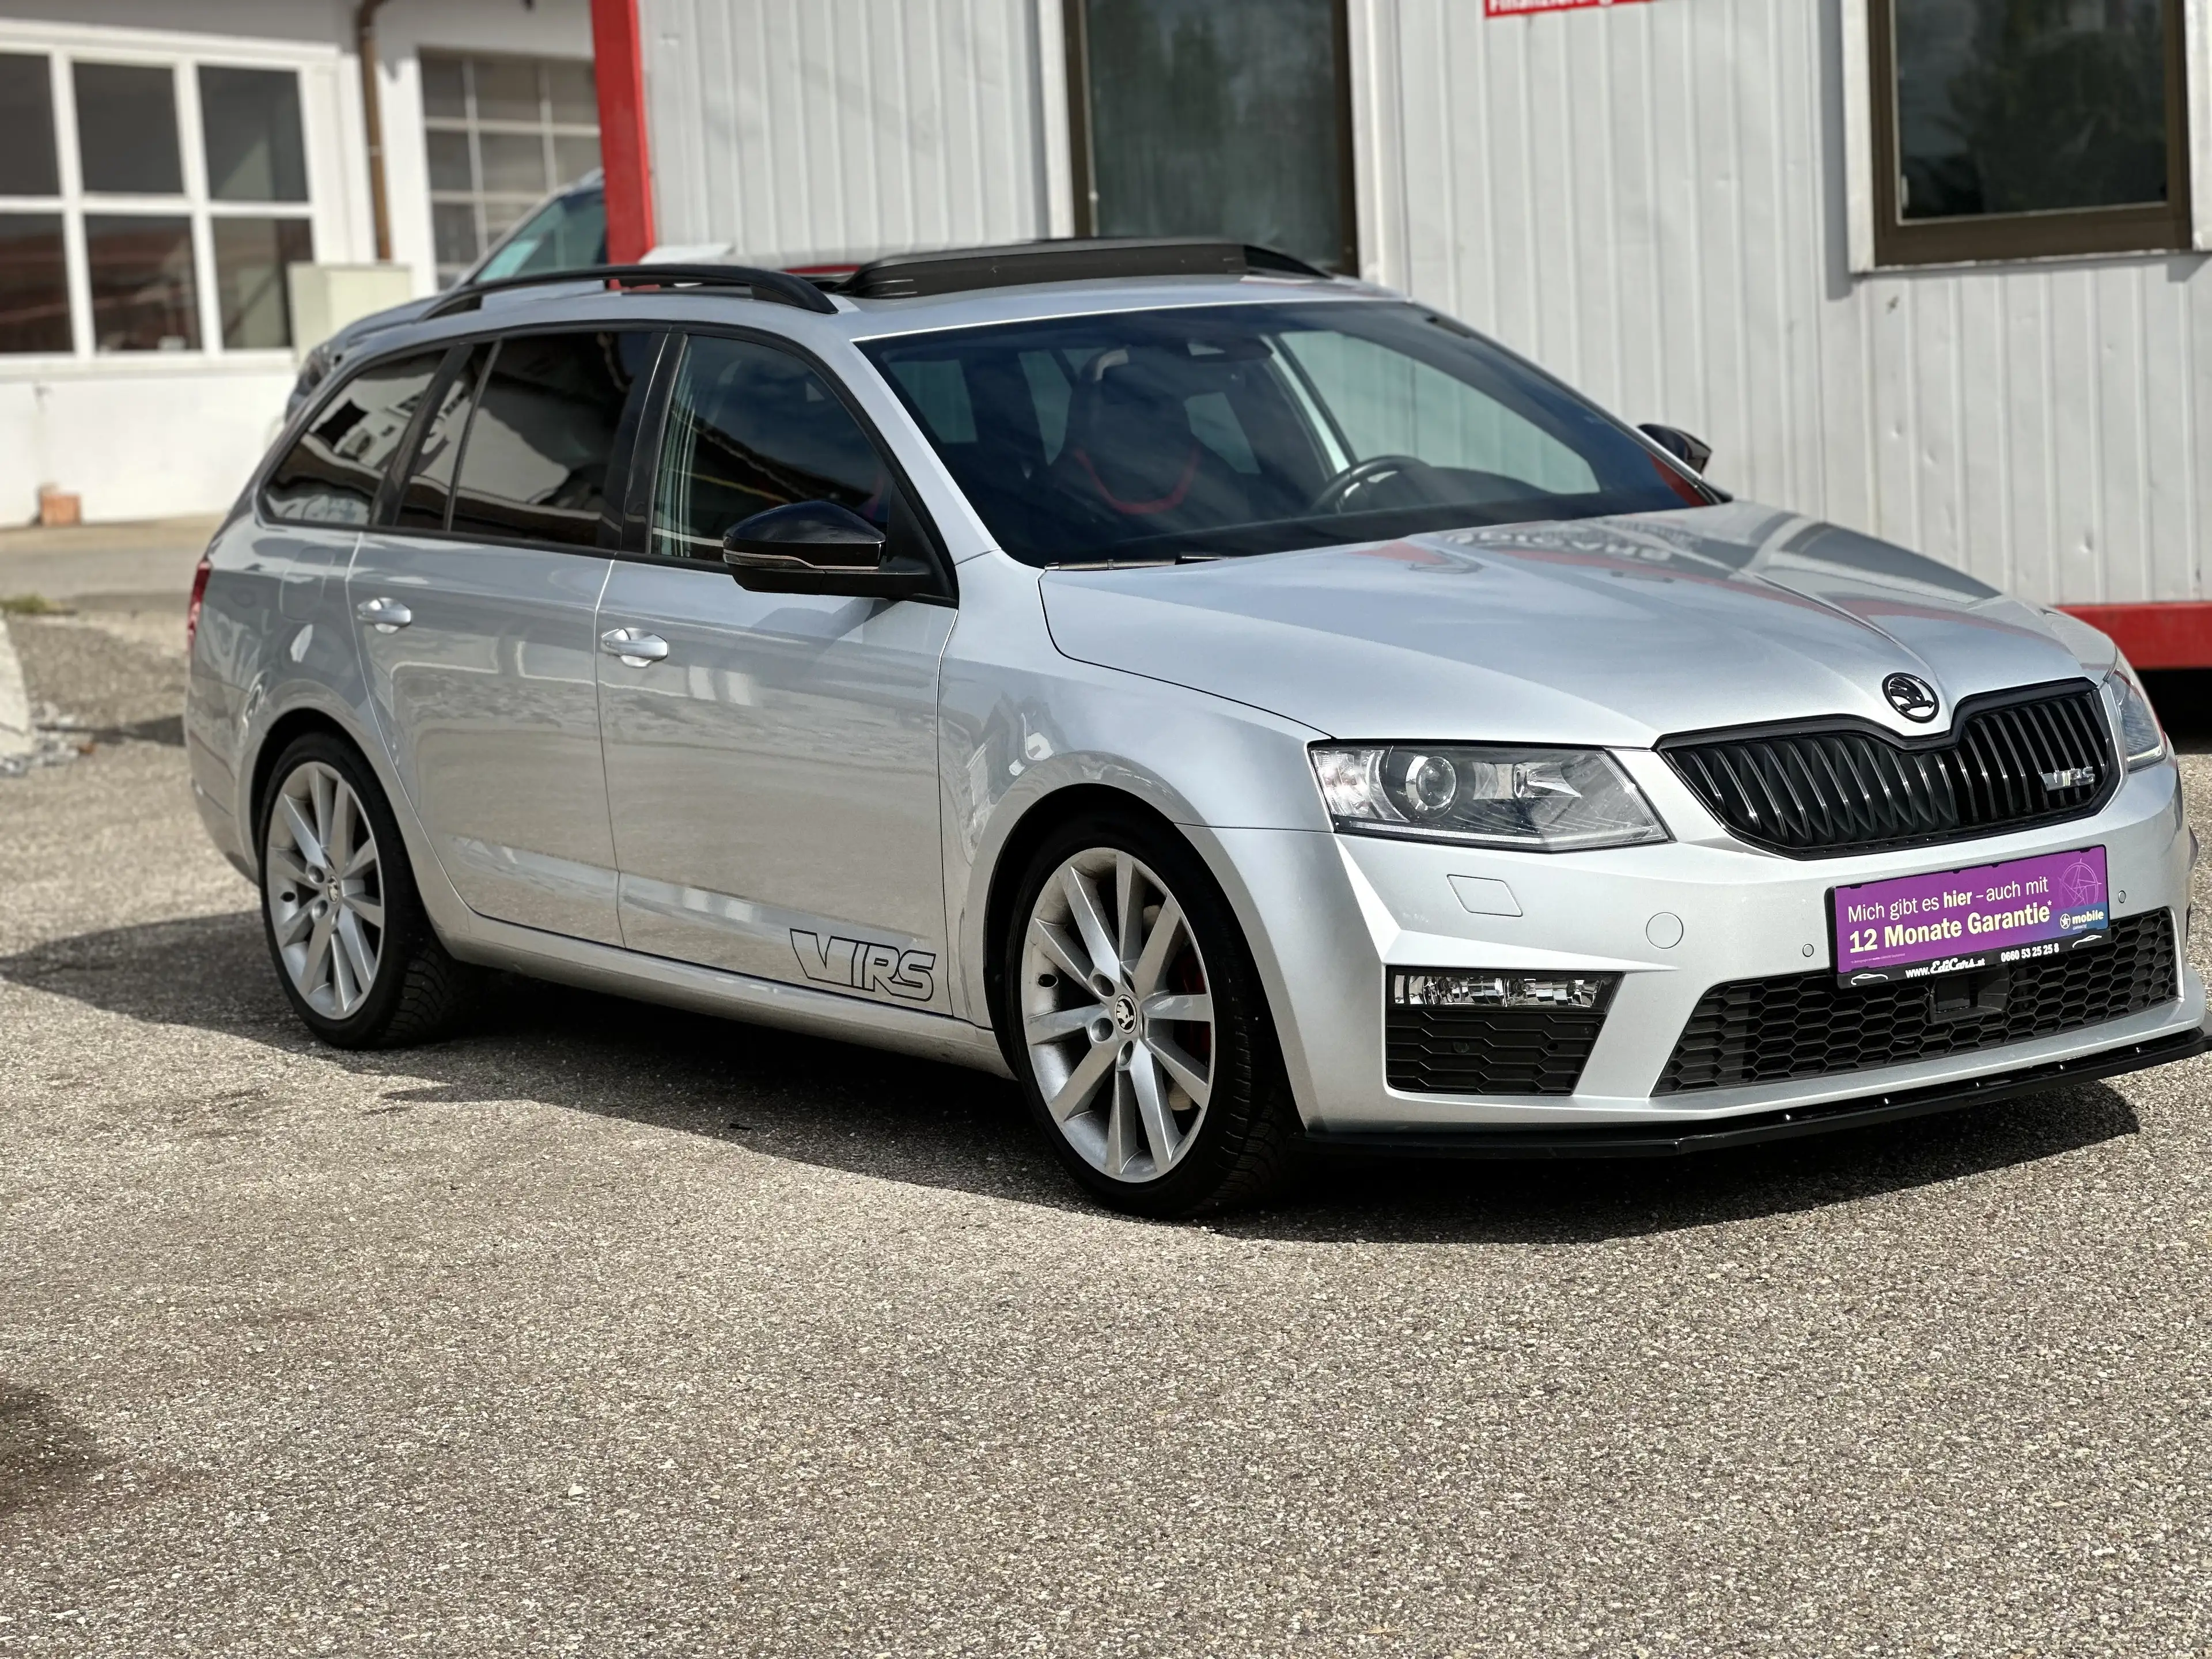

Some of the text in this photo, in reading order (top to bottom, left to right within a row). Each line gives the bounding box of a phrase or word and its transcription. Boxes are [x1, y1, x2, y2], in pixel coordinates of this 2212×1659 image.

[1848, 902, 1885, 923] Mich
[1890, 897, 1919, 921] gibt
[1922, 896, 1940, 911] es
[1943, 890, 1972, 908] hier
[1986, 881, 2020, 902] auch
[2026, 876, 2048, 895] mit
[2072, 910, 2104, 924] mobile
[1850, 928, 1878, 953] 12
[1884, 918, 1962, 948] Monate
[1906, 958, 1985, 978] www.EdiCars.at
[2001, 949, 2020, 962] 0660
[2021, 948, 2031, 959] 53
[2032, 946, 2041, 957] 25
[2043, 944, 2052, 955] 25
[2054, 943, 2059, 952] 8
